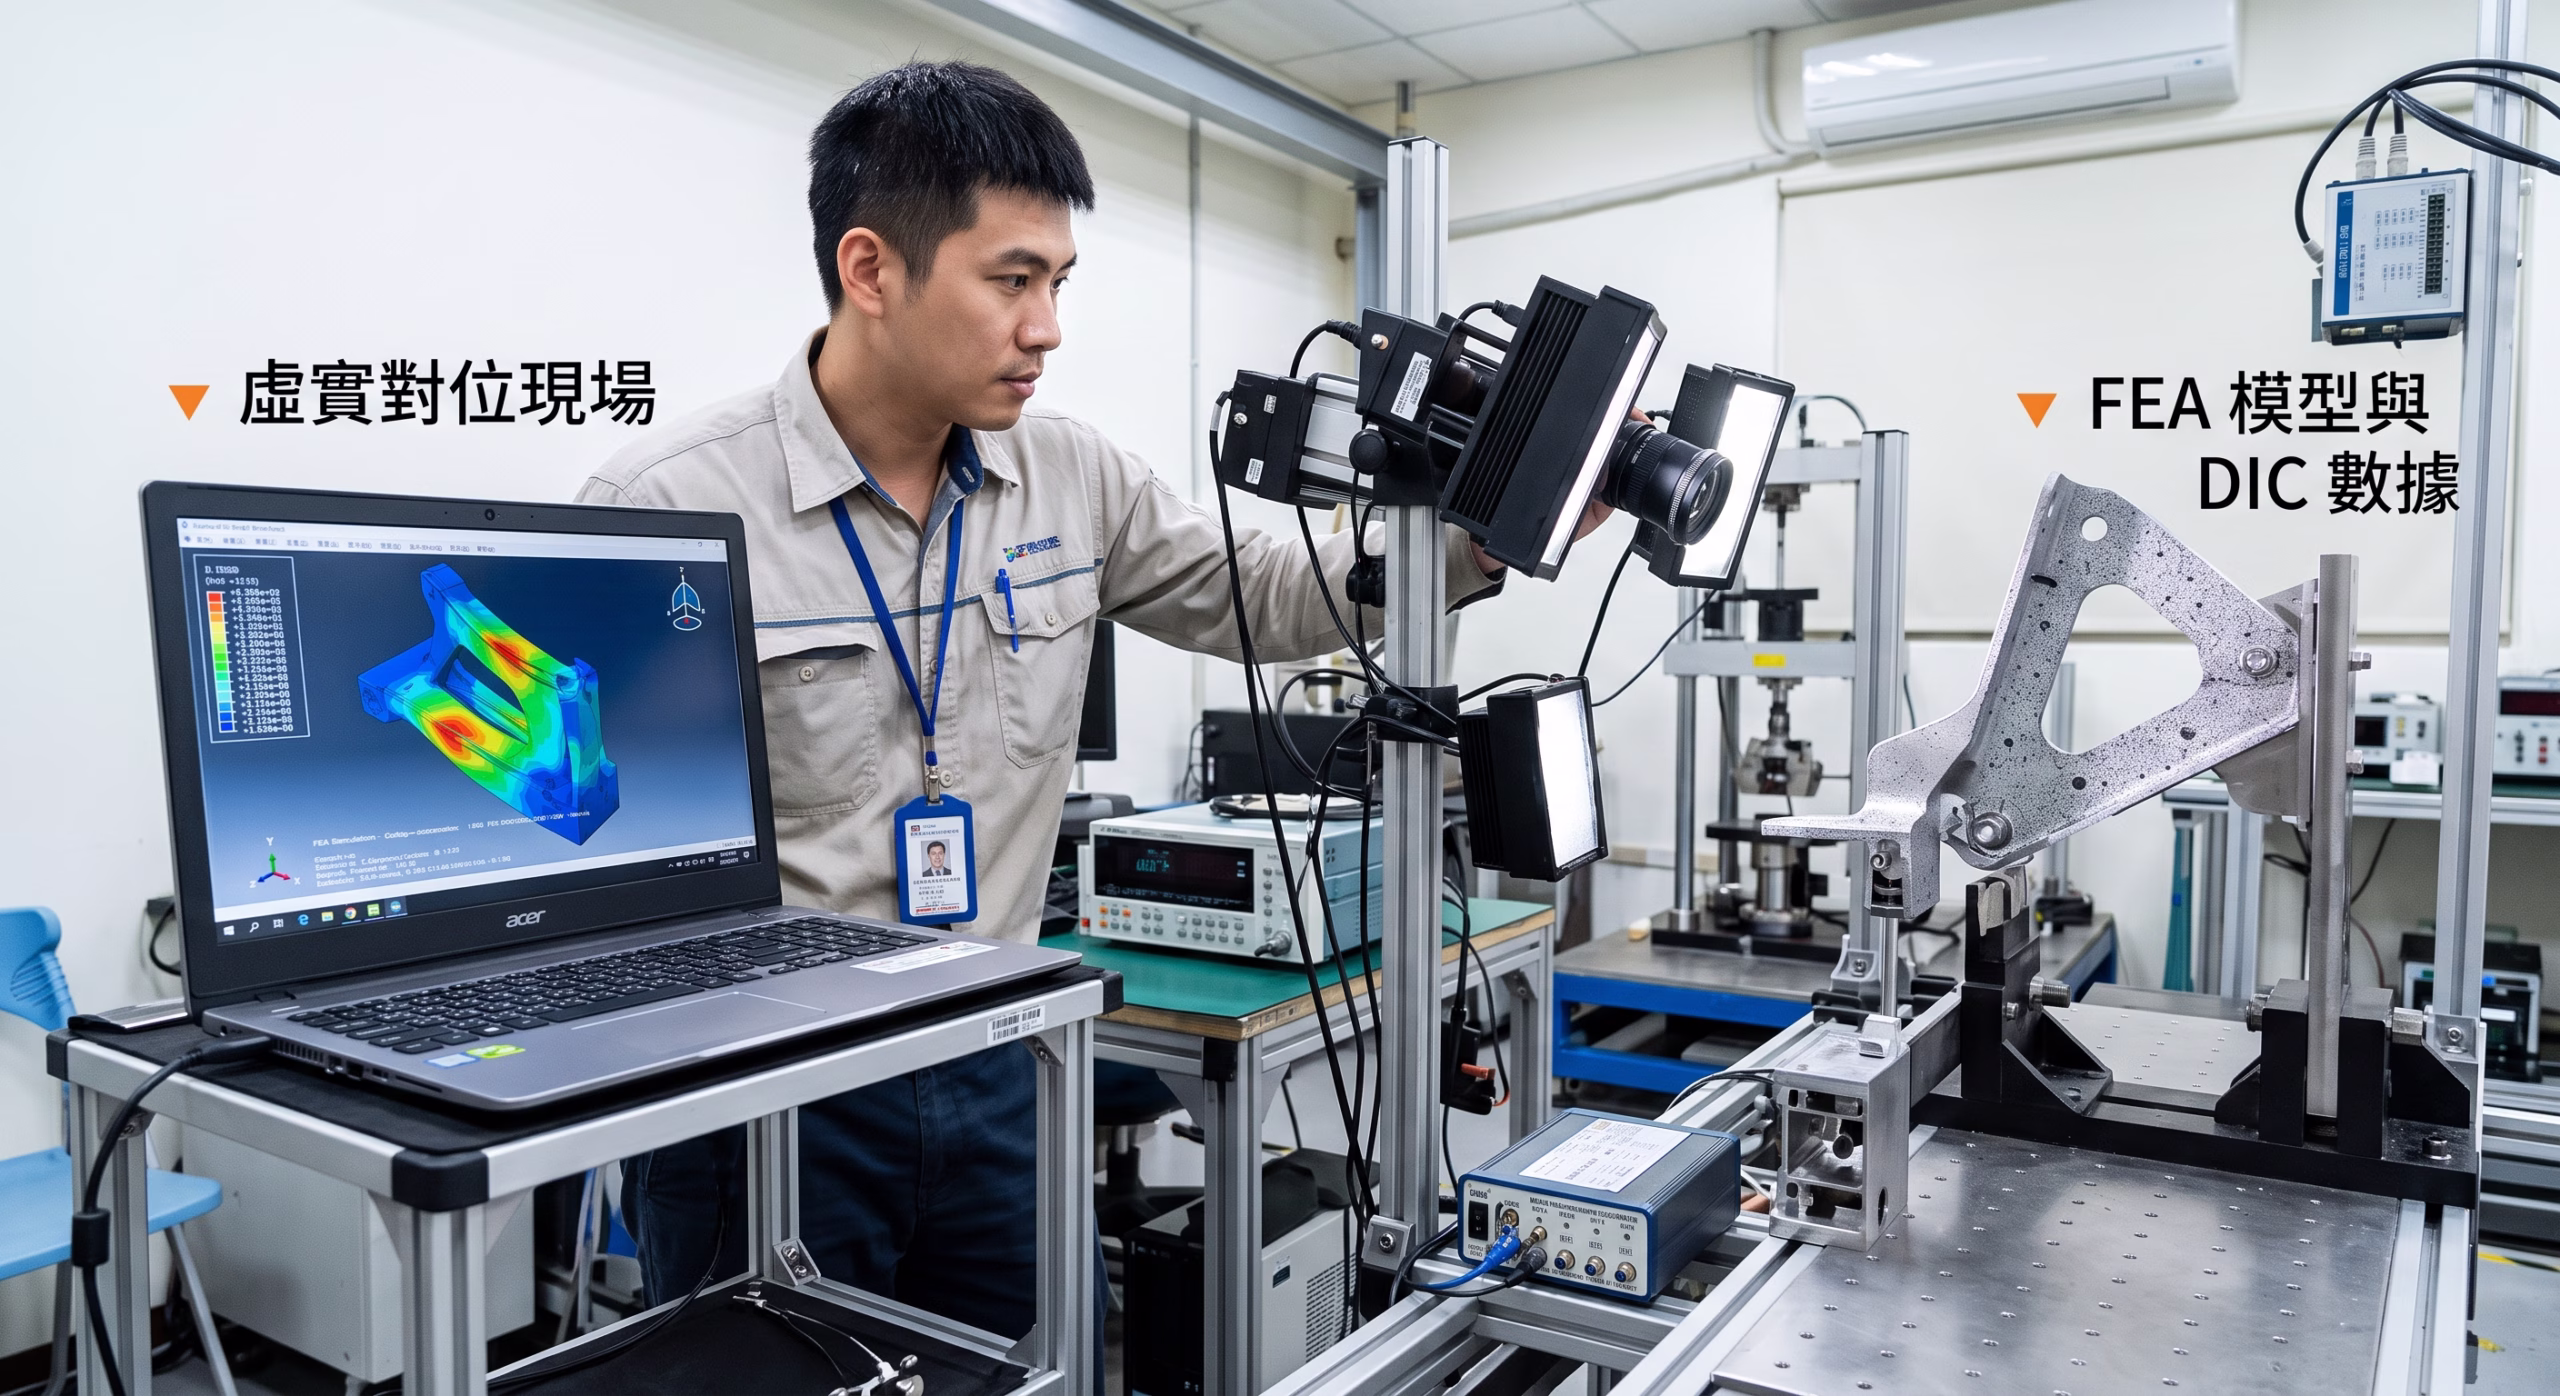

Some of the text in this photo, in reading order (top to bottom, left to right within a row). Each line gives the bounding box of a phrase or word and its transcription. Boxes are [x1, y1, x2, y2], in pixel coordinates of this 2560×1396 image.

[266, 836, 274, 846] Y
[294, 877, 301, 885] X
[505, 910, 546, 928] acer
